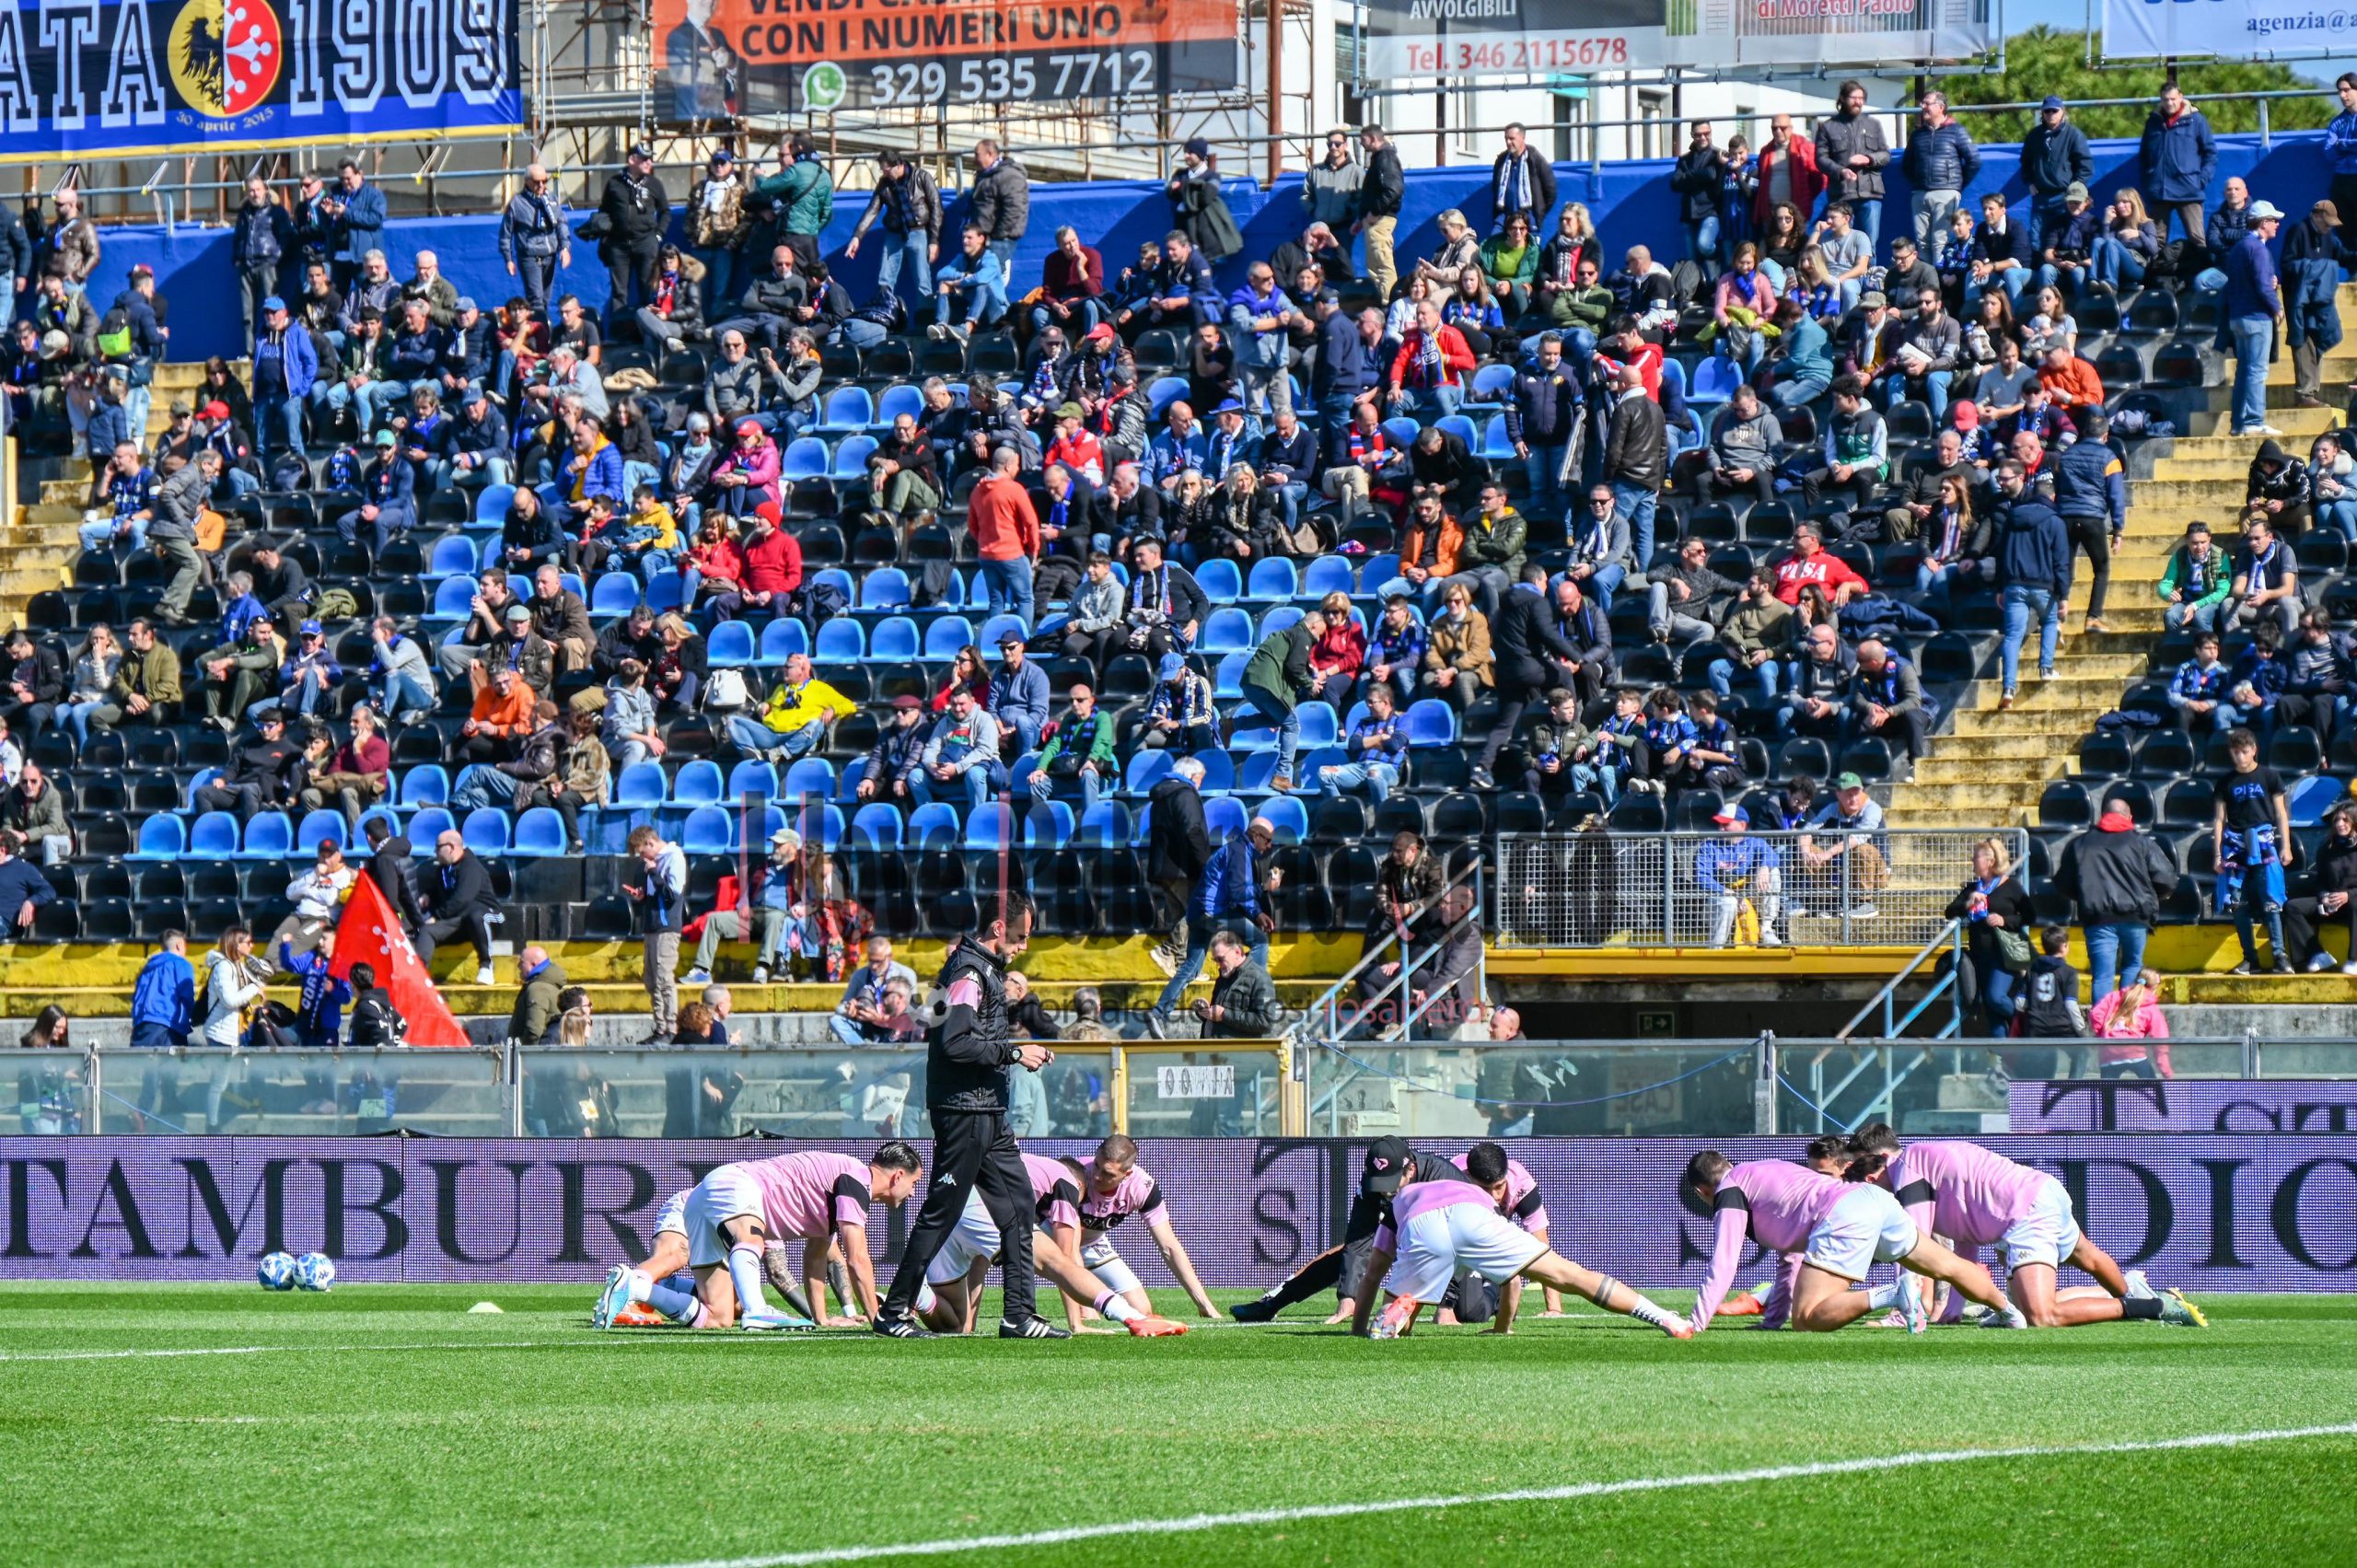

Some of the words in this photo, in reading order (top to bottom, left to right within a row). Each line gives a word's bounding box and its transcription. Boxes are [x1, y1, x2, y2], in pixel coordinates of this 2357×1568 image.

[742, 21, 825, 56] CON
[839, 19, 848, 52] I
[863, 10, 1018, 51] NUMERI
[1032, 5, 1122, 41] UNO
[1410, 0, 1517, 19] AVVOLGIBILI
[289, 0, 508, 117] 1909
[870, 62, 946, 105] 329
[959, 58, 1037, 100] 535
[1049, 50, 1155, 96] 7712
[1407, 42, 1451, 71] Tel.
[1458, 41, 1506, 70] 346
[1513, 37, 1628, 68] 2115678
